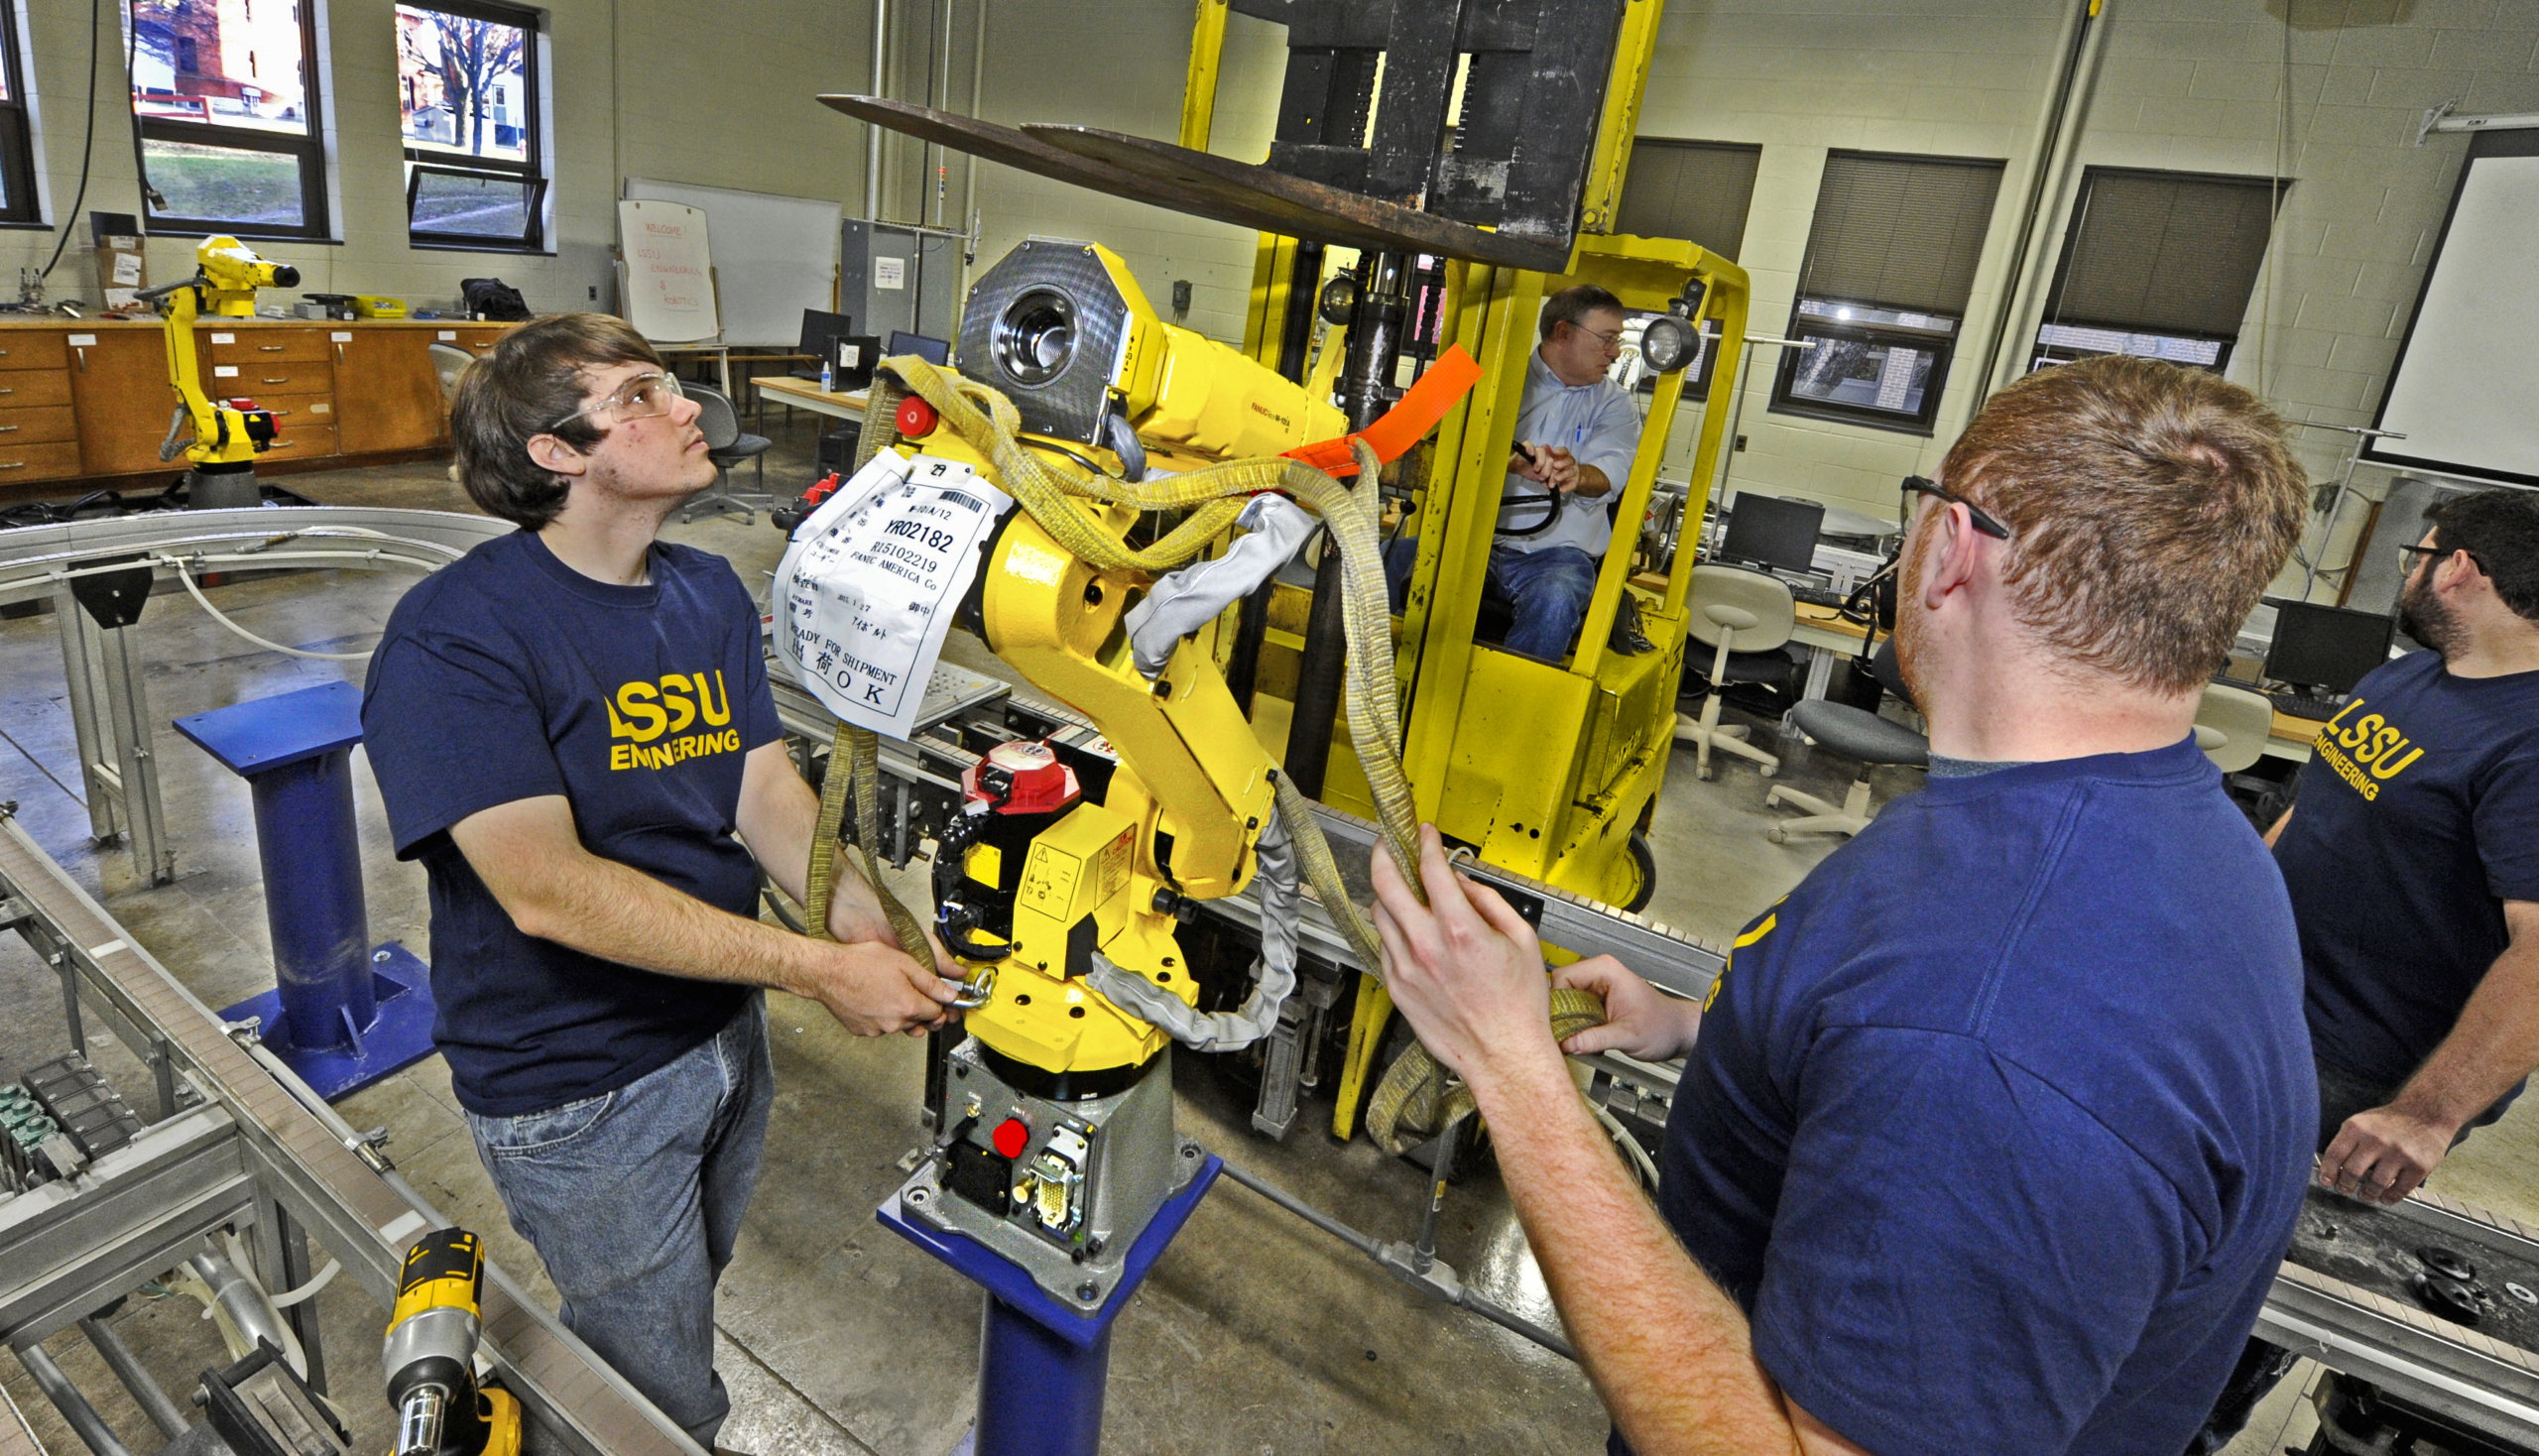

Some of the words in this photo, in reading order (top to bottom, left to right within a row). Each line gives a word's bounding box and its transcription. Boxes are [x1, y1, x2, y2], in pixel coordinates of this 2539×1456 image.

[637, 249, 660, 260] LSSU
[651, 264, 702, 278] ENGINEERING
[663, 295, 699, 306] ROBOTICS
[930, 463, 947, 477] 29
[870, 541, 938, 573] R15102219
[878, 559, 920, 584] AMERICA
[789, 622, 820, 645] READY
[824, 639, 842, 658] FOR
[842, 652, 898, 686] SHIPMENT
[603, 669, 731, 743] LSSU
[2326, 697, 2425, 780] LSSU
